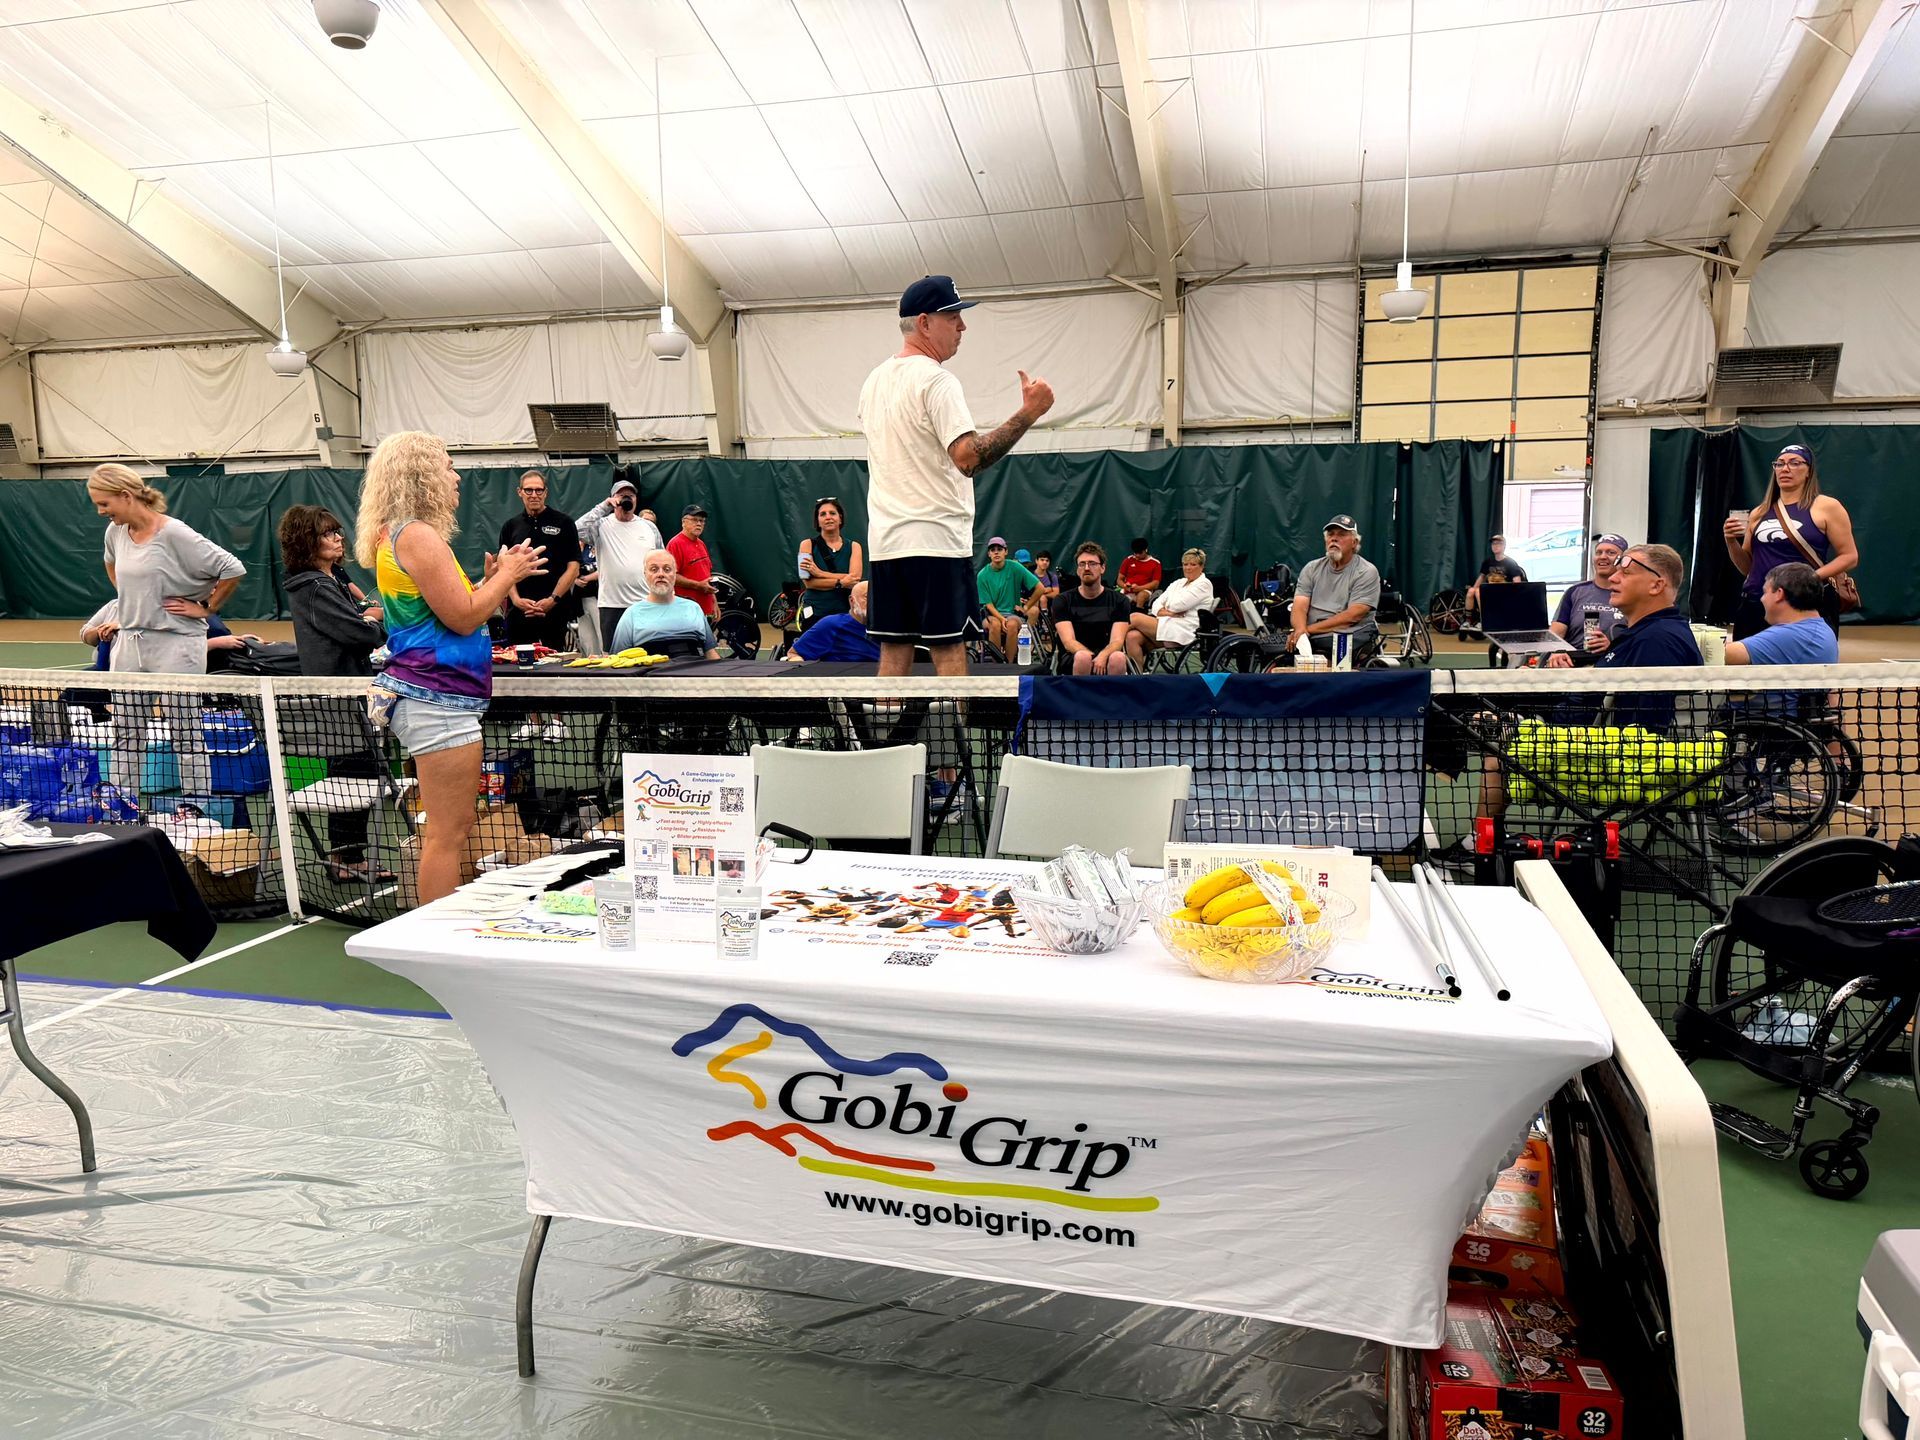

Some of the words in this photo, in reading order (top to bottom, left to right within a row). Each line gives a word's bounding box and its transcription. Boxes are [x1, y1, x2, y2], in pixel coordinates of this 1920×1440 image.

[1167, 378, 1176, 391] 7
[314, 413, 321, 423] 6
[1325, 989, 1456, 1004] www.gobigrip.com
[824, 1190, 1135, 1247] www.gobigrip.com
[1466, 1240, 1490, 1256] 36
[1450, 1364, 1470, 1378] 32
[1583, 1411, 1606, 1427] 32
[1463, 1426, 1484, 1435] Dot's
[1583, 1426, 1605, 1434] BAGS
